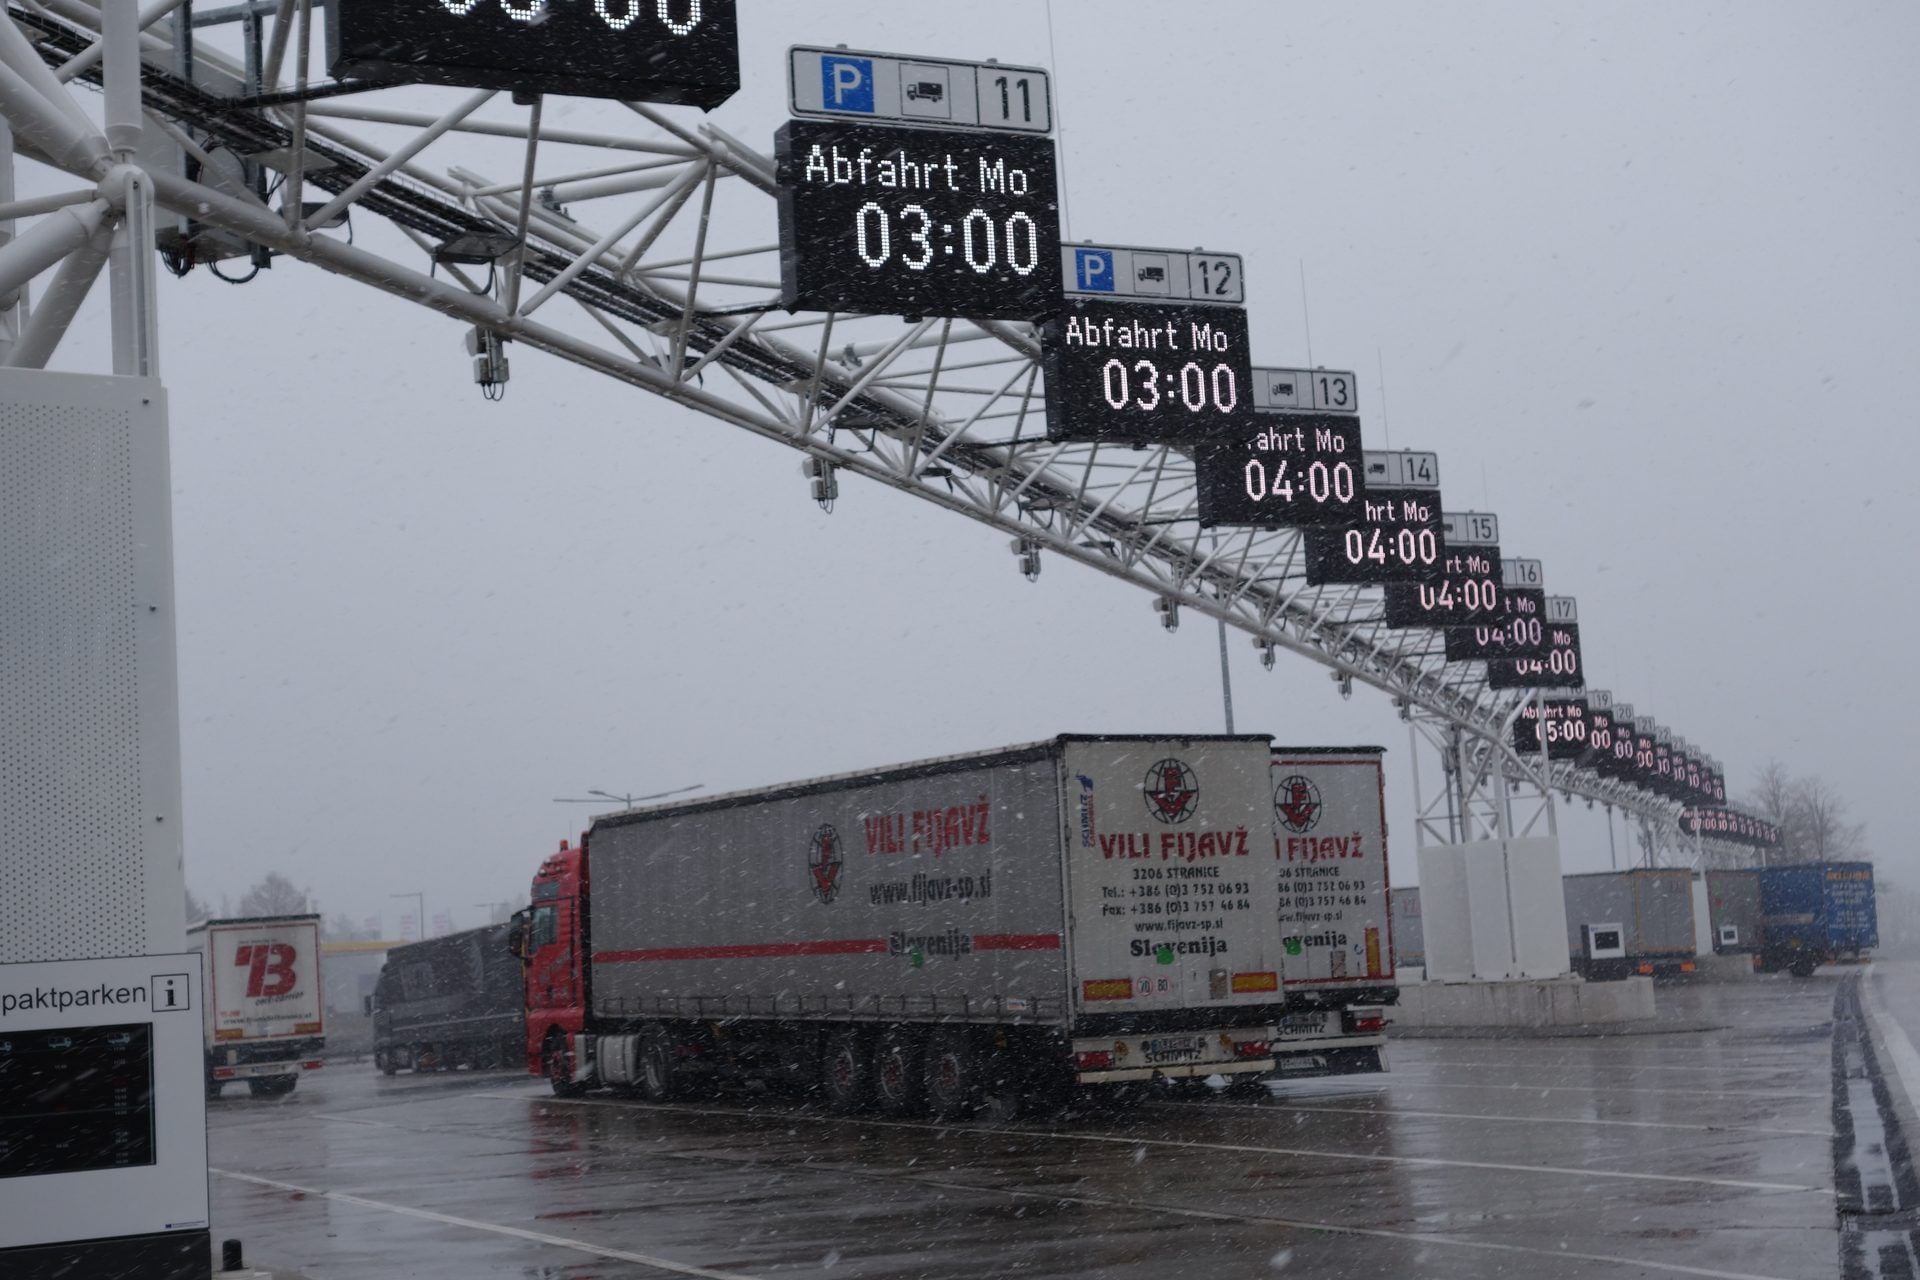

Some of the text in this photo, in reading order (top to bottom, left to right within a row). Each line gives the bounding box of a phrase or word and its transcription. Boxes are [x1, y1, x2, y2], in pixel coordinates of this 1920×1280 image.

[833, 63, 1031, 122] P 11
[806, 144, 1028, 194] Abfahrt Mo
[856, 201, 1038, 275] 03:00
[1084, 254, 1232, 295] P 12
[1066, 315, 1228, 352] Abfahrt Mo
[1103, 359, 1237, 413] 03:00
[1320, 377, 1348, 405] 13
[1248, 426, 1345, 453] ahrt Mo
[1407, 457, 1431, 482] 14
[1245, 459, 1354, 503] 04:00
[1403, 500, 1429, 522] Mo
[1472, 518, 1492, 539] 15
[1345, 528, 1437, 565] 04:00
[1468, 556, 1490, 574] Mo
[1520, 564, 1537, 582] 16
[1420, 579, 1497, 610] 04:00
[1517, 597, 1536, 613] Mo
[1556, 601, 1571, 617] 17
[1553, 630, 1571, 645] Mo
[1567, 704, 1582, 718] Mo
[1594, 716, 1608, 727] Mo
[865, 814, 905, 855] VILI
[1099, 825, 1250, 863] VILI FIJAVŽ
[1287, 831, 1364, 863] FIJAVŽ
[1133, 866, 1220, 880] 3206 STRANICE
[1295, 867, 1340, 878] STRANICE
[1129, 885, 1161, 897] +386
[1192, 883, 1214, 895] 752
[1130, 902, 1161, 914] +386
[1135, 917, 1223, 933] www.fijavz-sp.si
[1130, 936, 1228, 957] Slovenija
[1276, 1023, 1326, 1036] SCHMITZ
